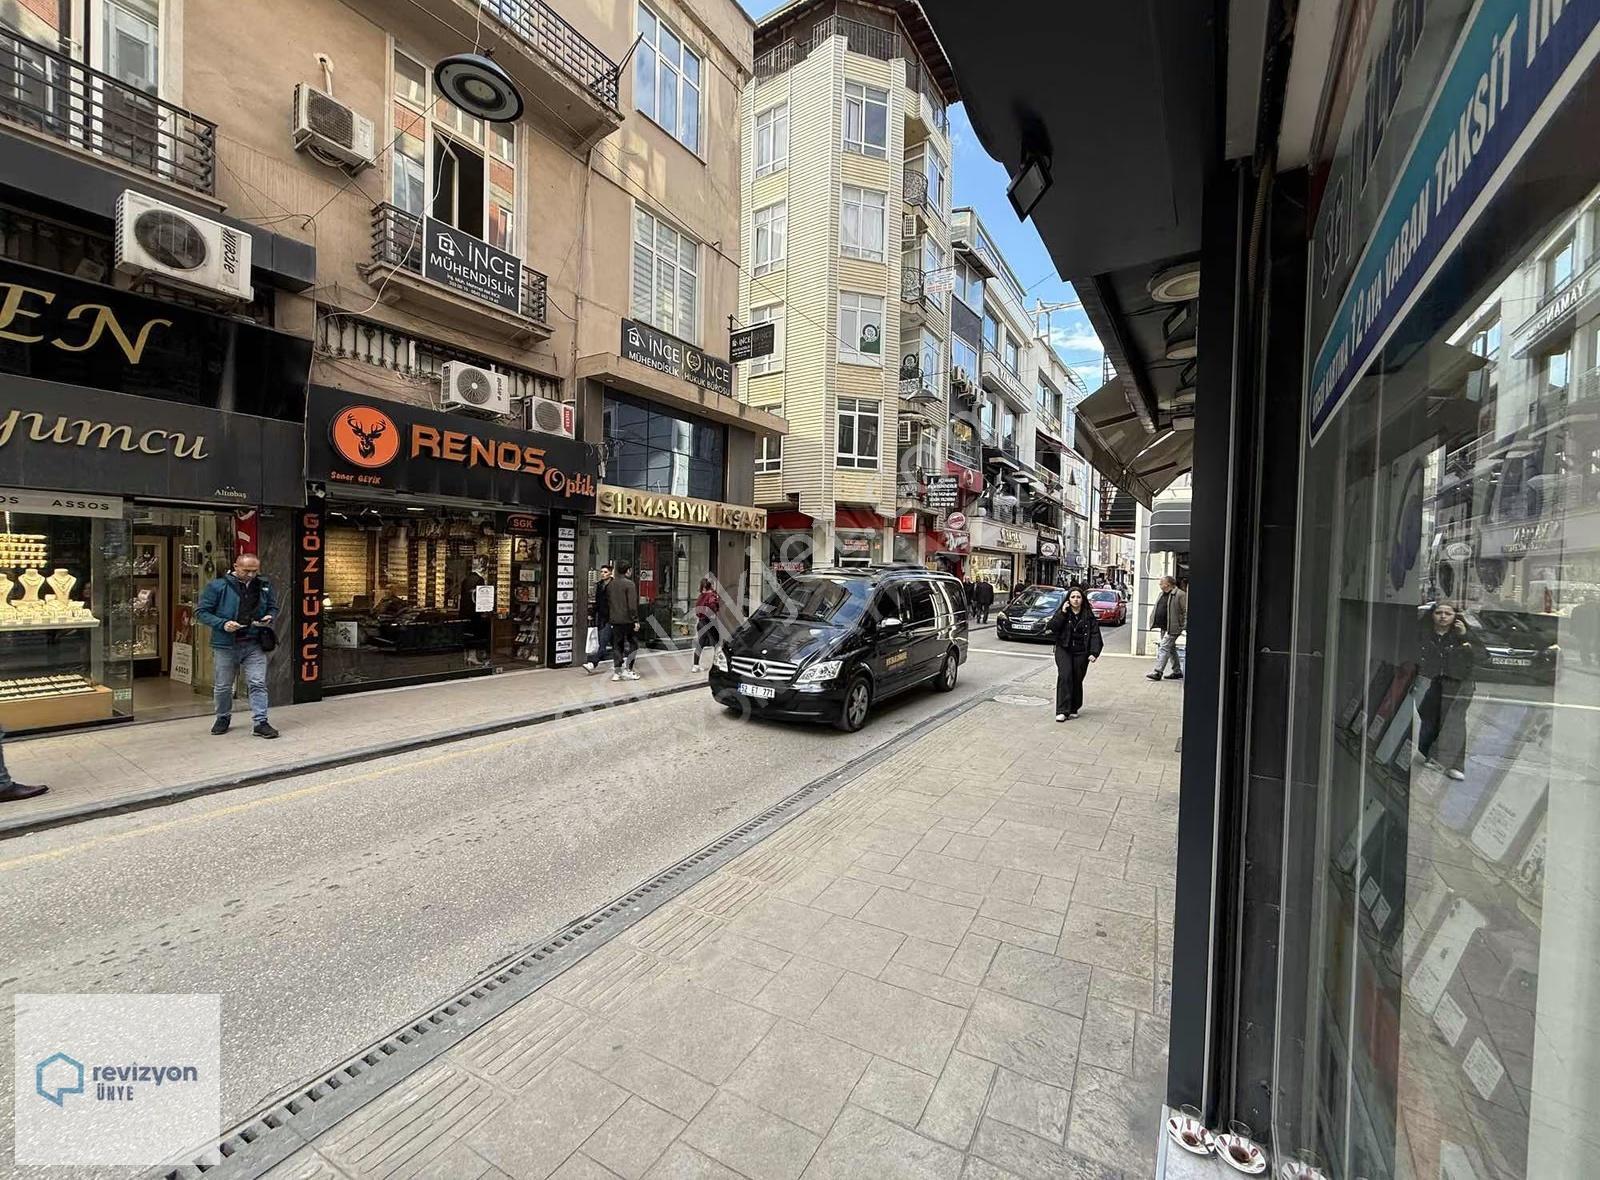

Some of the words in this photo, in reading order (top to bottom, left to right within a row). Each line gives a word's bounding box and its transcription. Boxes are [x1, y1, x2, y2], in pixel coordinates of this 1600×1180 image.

[1351, 287, 1366, 356] 12
[1364, 270, 1383, 334] AYA
[1385, 178, 1430, 294] VARAN
[1435, 13, 1519, 217] TAKSİT
[430, 252, 516, 298] MÜHENDİSLİK
[468, 241, 516, 281] İNCE
[628, 351, 680, 377] MÜHENDİSLİK
[649, 335, 680, 363] İNCE
[703, 358, 729, 383] İNCE
[410, 424, 546, 475] RENOS
[544, 467, 597, 497] Optik
[52, 499, 110, 511] ASSOS
[601, 491, 711, 523] SIRMABIYIK
[715, 503, 767, 530] İNŞAAT
[513, 518, 533, 529] SGK
